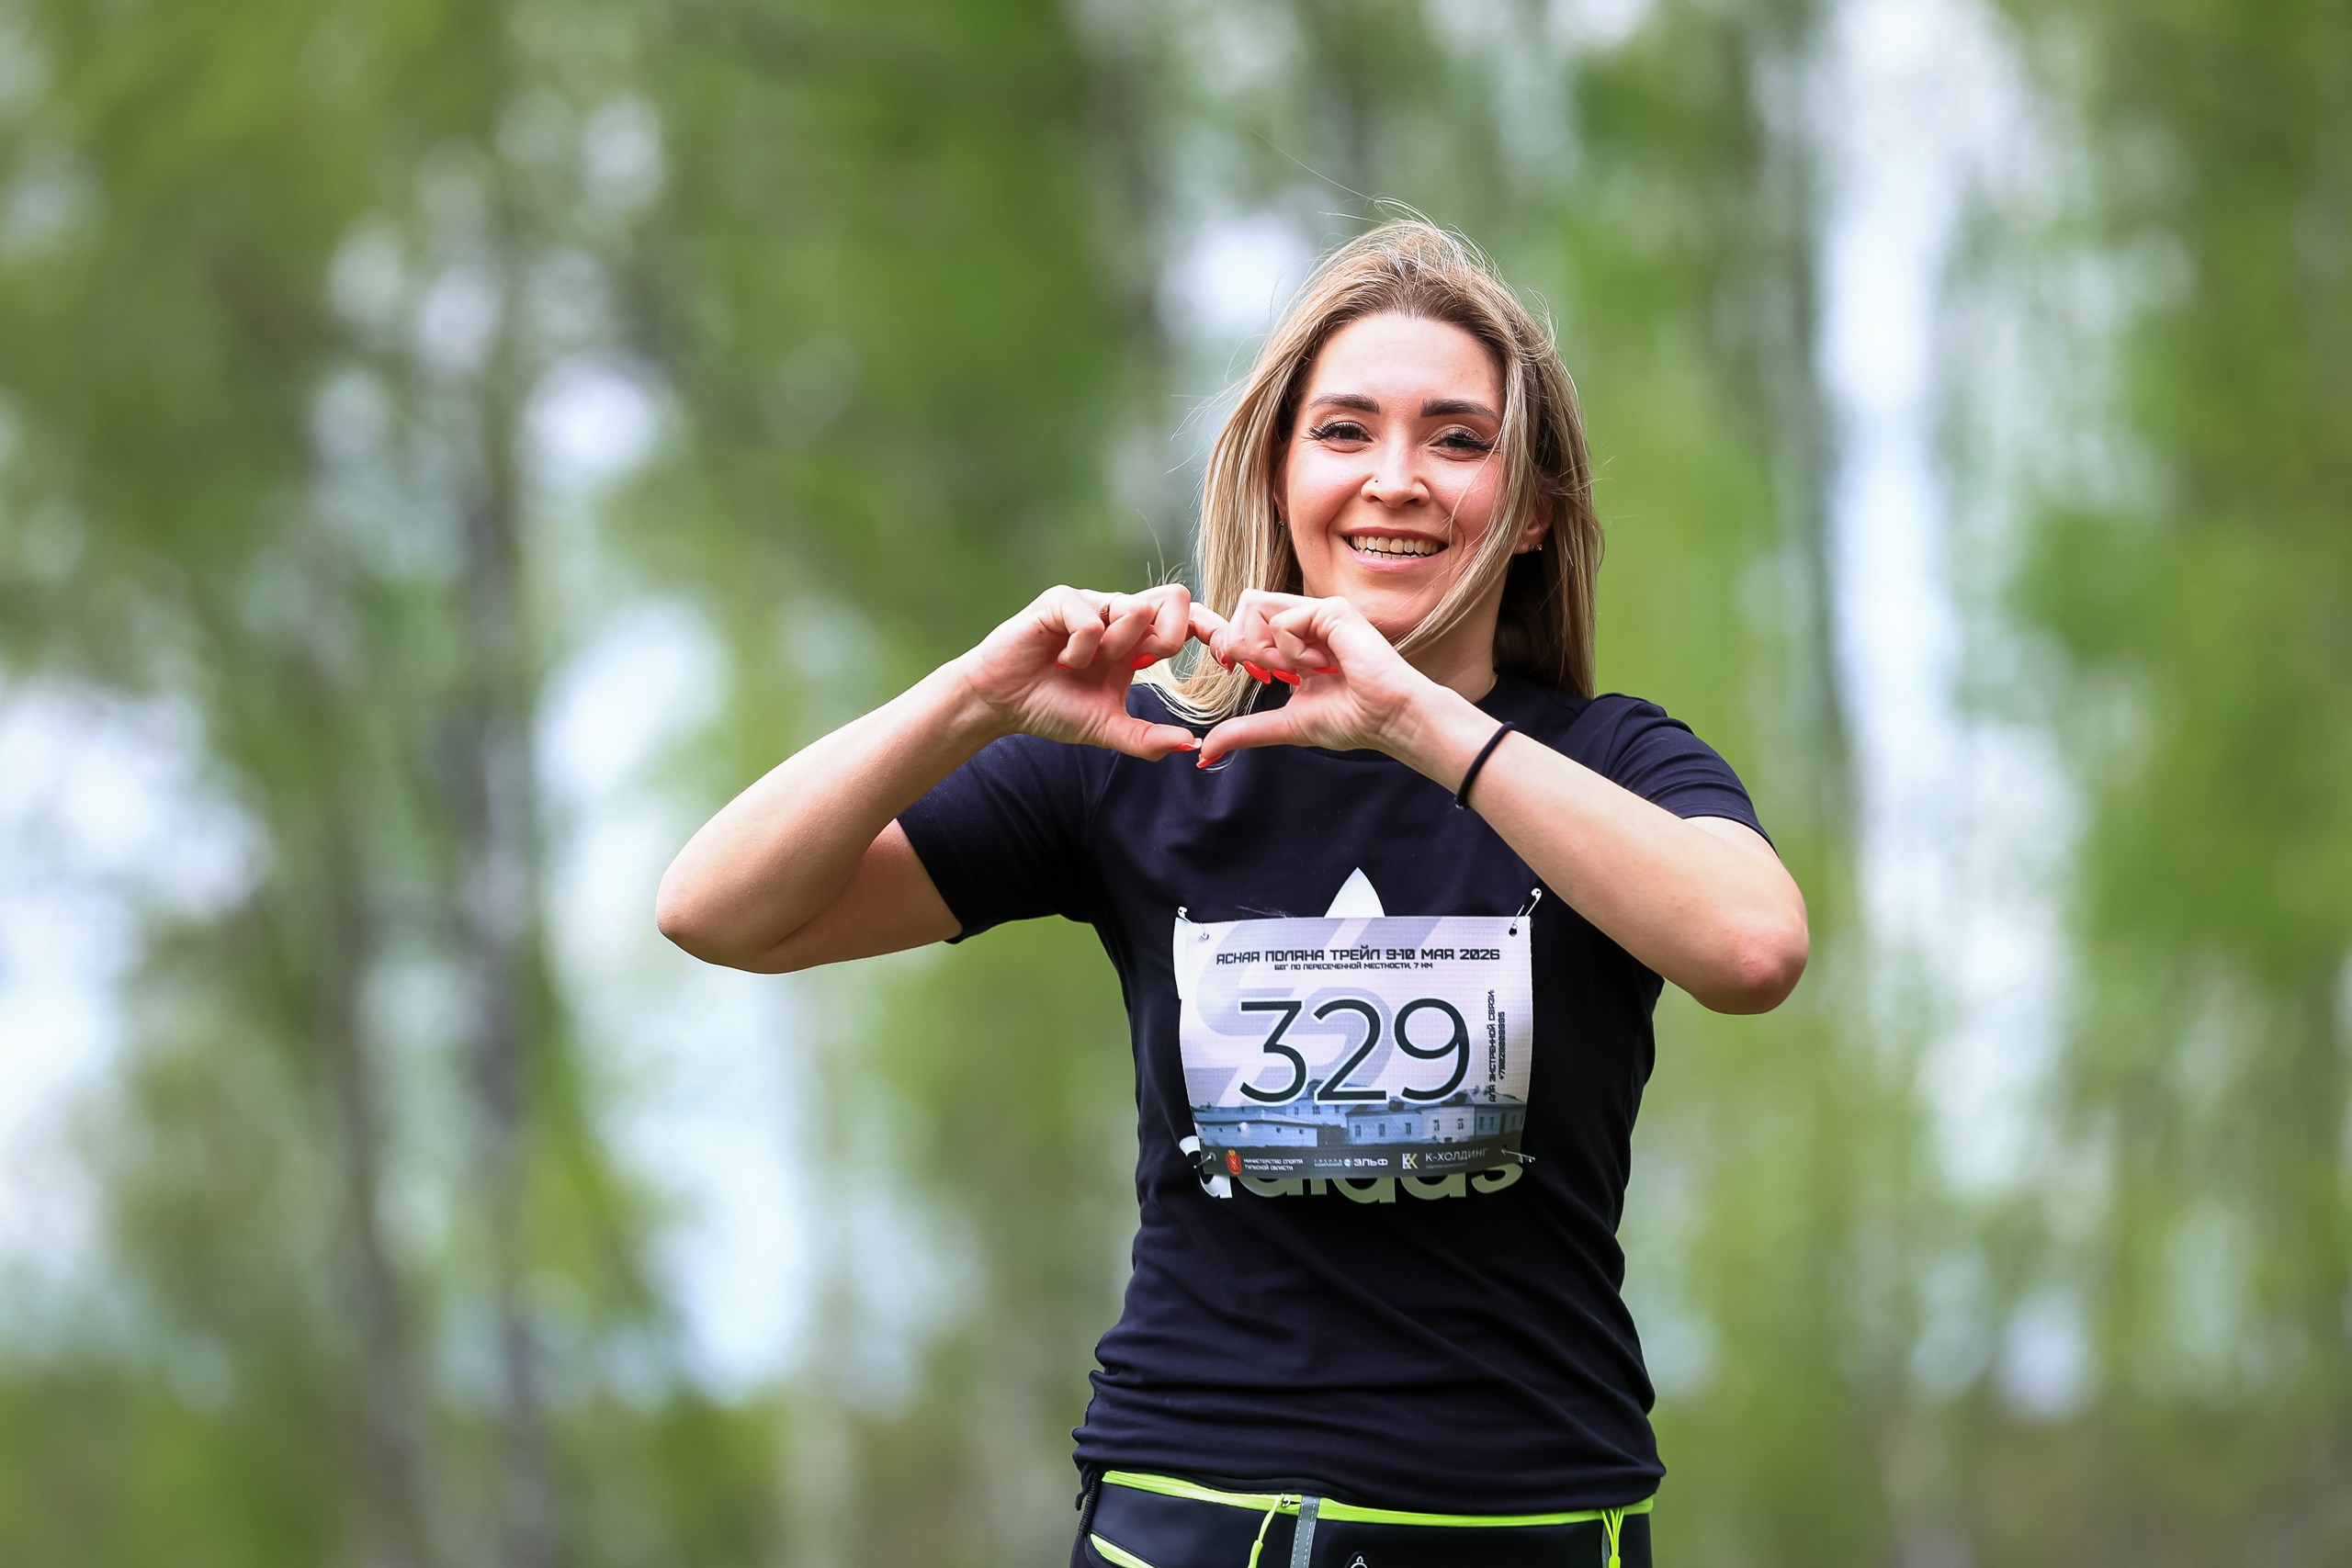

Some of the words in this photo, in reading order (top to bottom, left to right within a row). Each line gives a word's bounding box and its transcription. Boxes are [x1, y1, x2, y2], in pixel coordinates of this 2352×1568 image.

[1216, 951, 1261, 964] ЯСНАЯ
[1265, 949, 1325, 962] ПОЛЯНА
[1329, 944, 1380, 961] ТРЕЙЛ
[1386, 949, 1415, 960] 9-10
[1421, 949, 1454, 960] МАЯ
[1460, 949, 1500, 960] 2026
[1304, 962, 1362, 970] ПЕРЕСЕЧЕННОЙ
[1240, 998, 1470, 1102] 329
[1487, 1024, 1496, 1082] ЭКСТРЕННОЙ
[1353, 1157, 1389, 1167] ЭЛЬФ
[1425, 1148, 1488, 1162] К-ХОЛДИНГ
